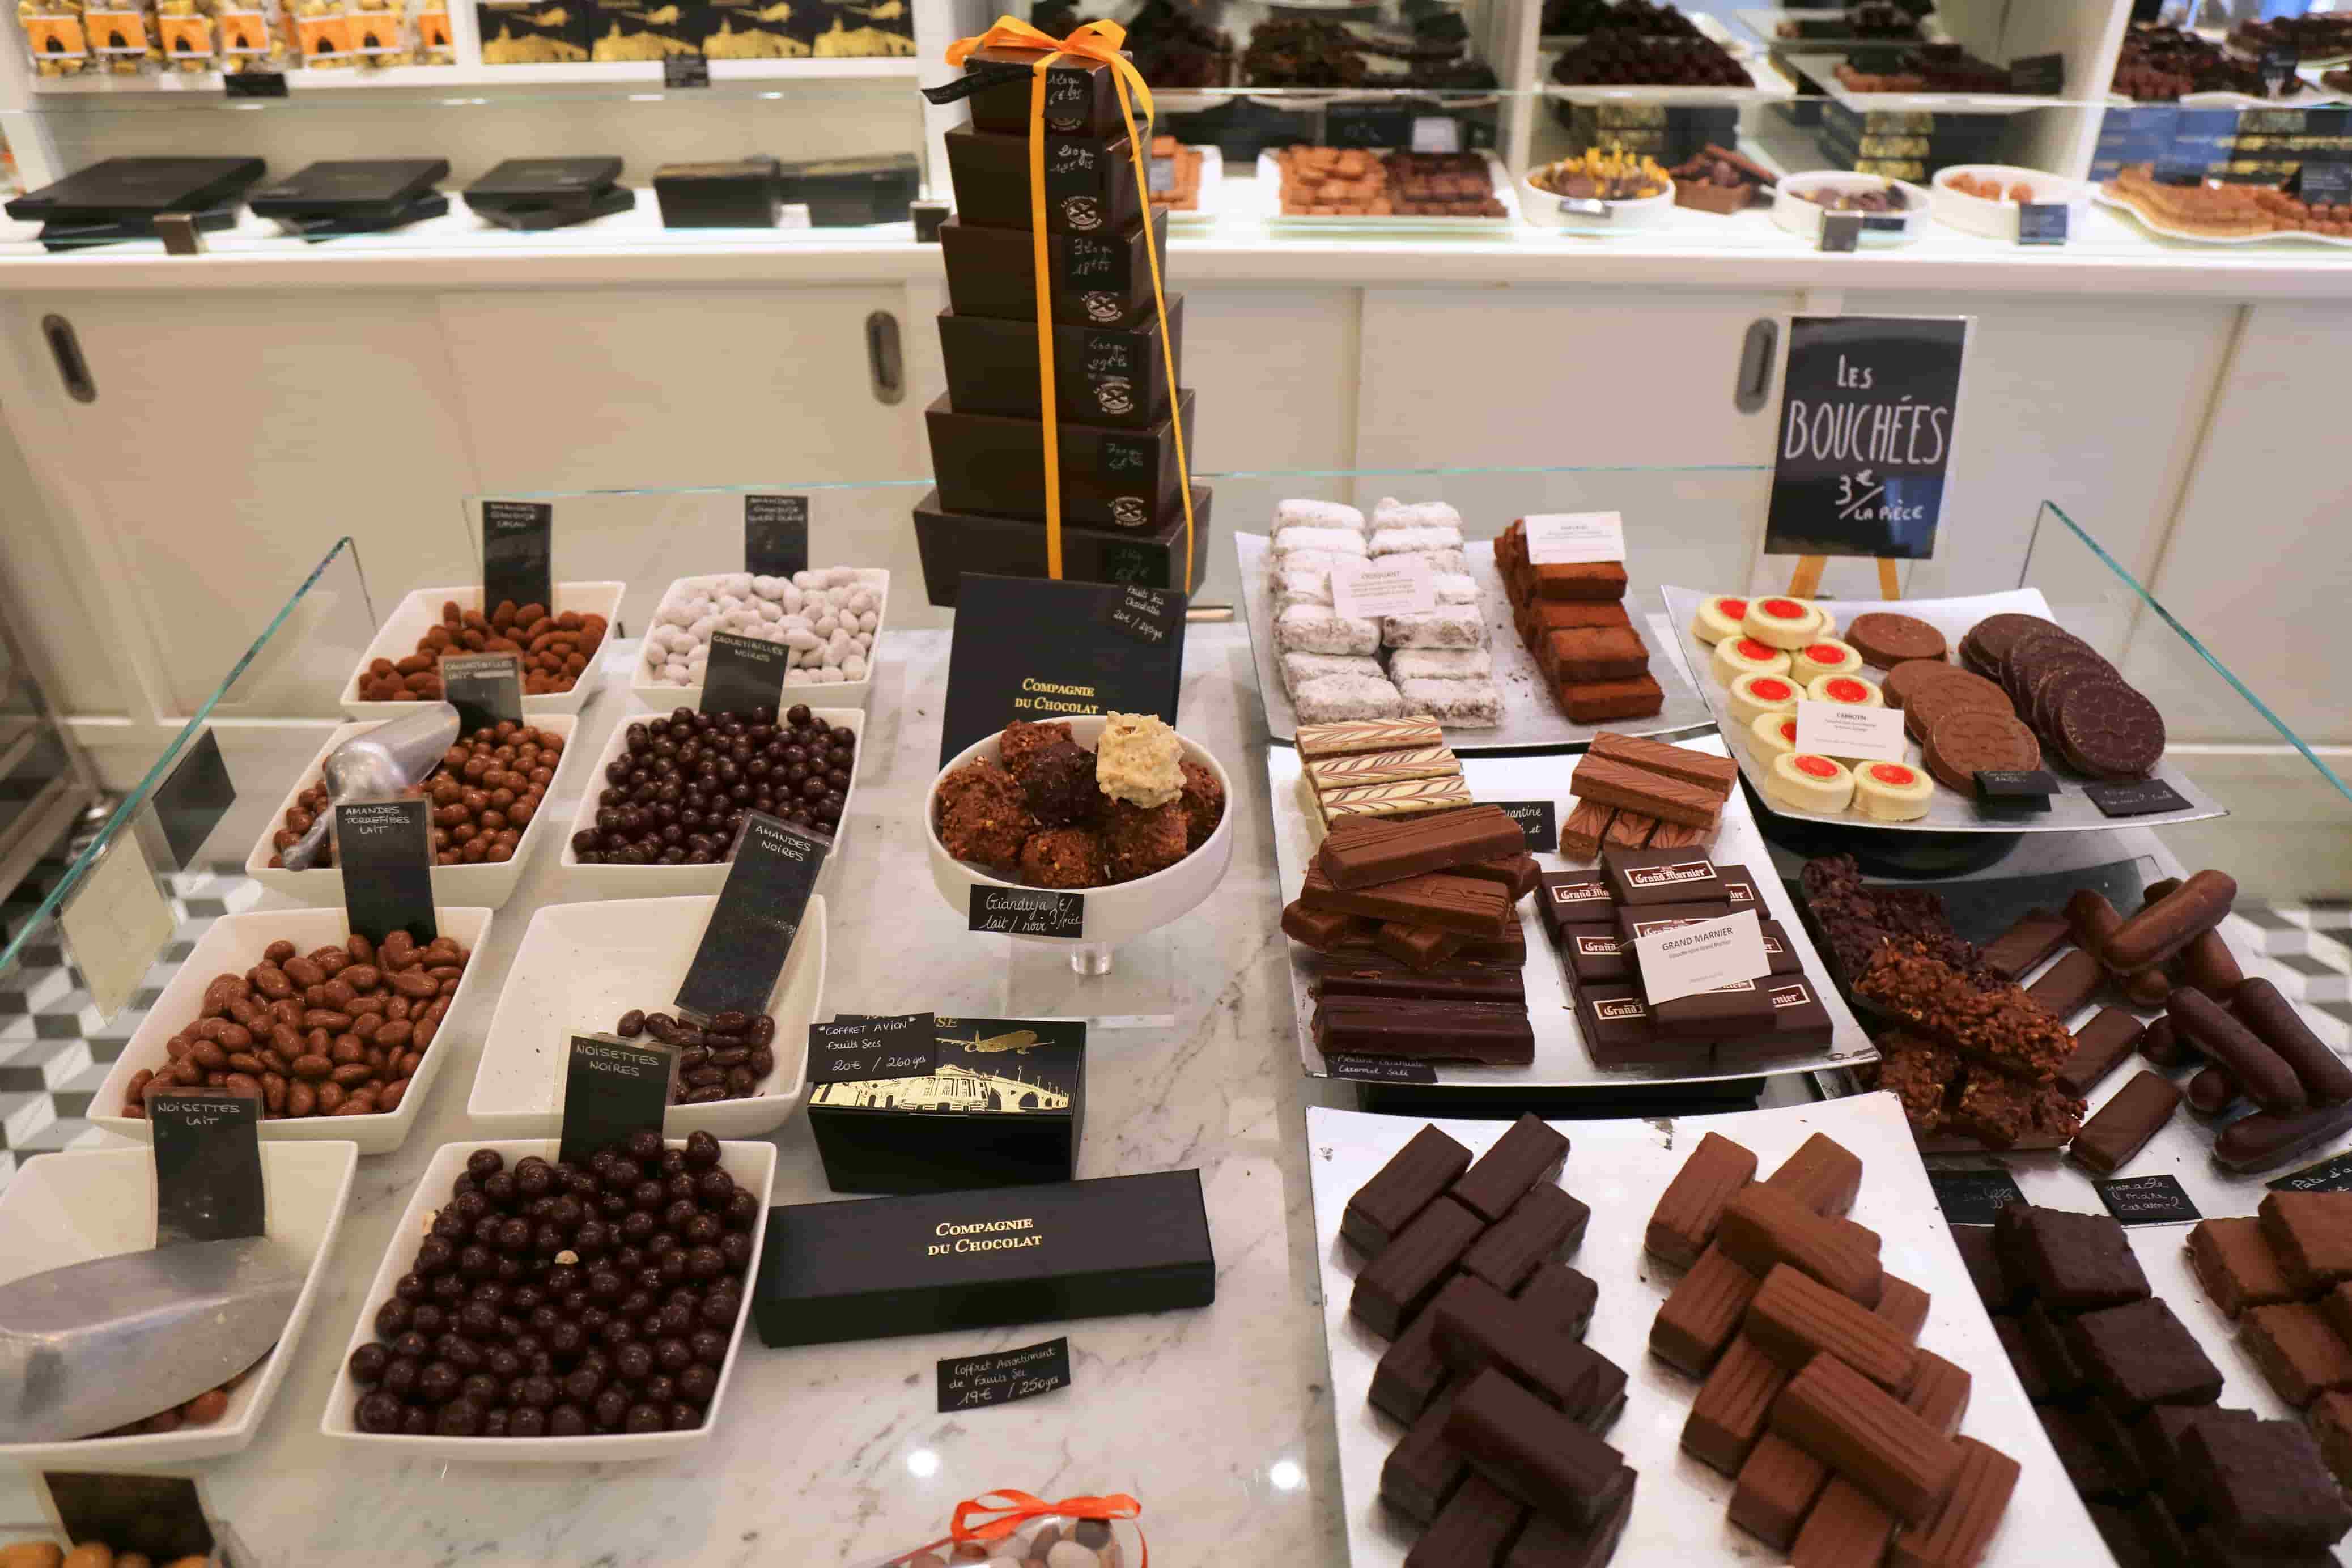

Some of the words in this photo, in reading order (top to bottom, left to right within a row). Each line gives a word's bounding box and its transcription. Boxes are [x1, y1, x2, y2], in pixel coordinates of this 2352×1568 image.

[1837, 354, 1873, 389] LES
[1784, 395, 1948, 464] BOUCHÉES
[1014, 698, 1031, 708] DU
[346, 806, 399, 815] AMANDES
[755, 825, 811, 852] AMANDES
[1662, 937, 1692, 951] GRAND
[1695, 927, 1733, 942] MARNIER
[576, 1044, 659, 1066] NOISETTES
[833, 1059, 861, 1071] 20€
[158, 1102, 241, 1113] NOISETTES
[936, 1219, 1034, 1236] COMPAGNIE
[928, 1244, 950, 1256] DU
[955, 1235, 1043, 1253] CHOCOLAT
[949, 1380, 965, 1389] de
